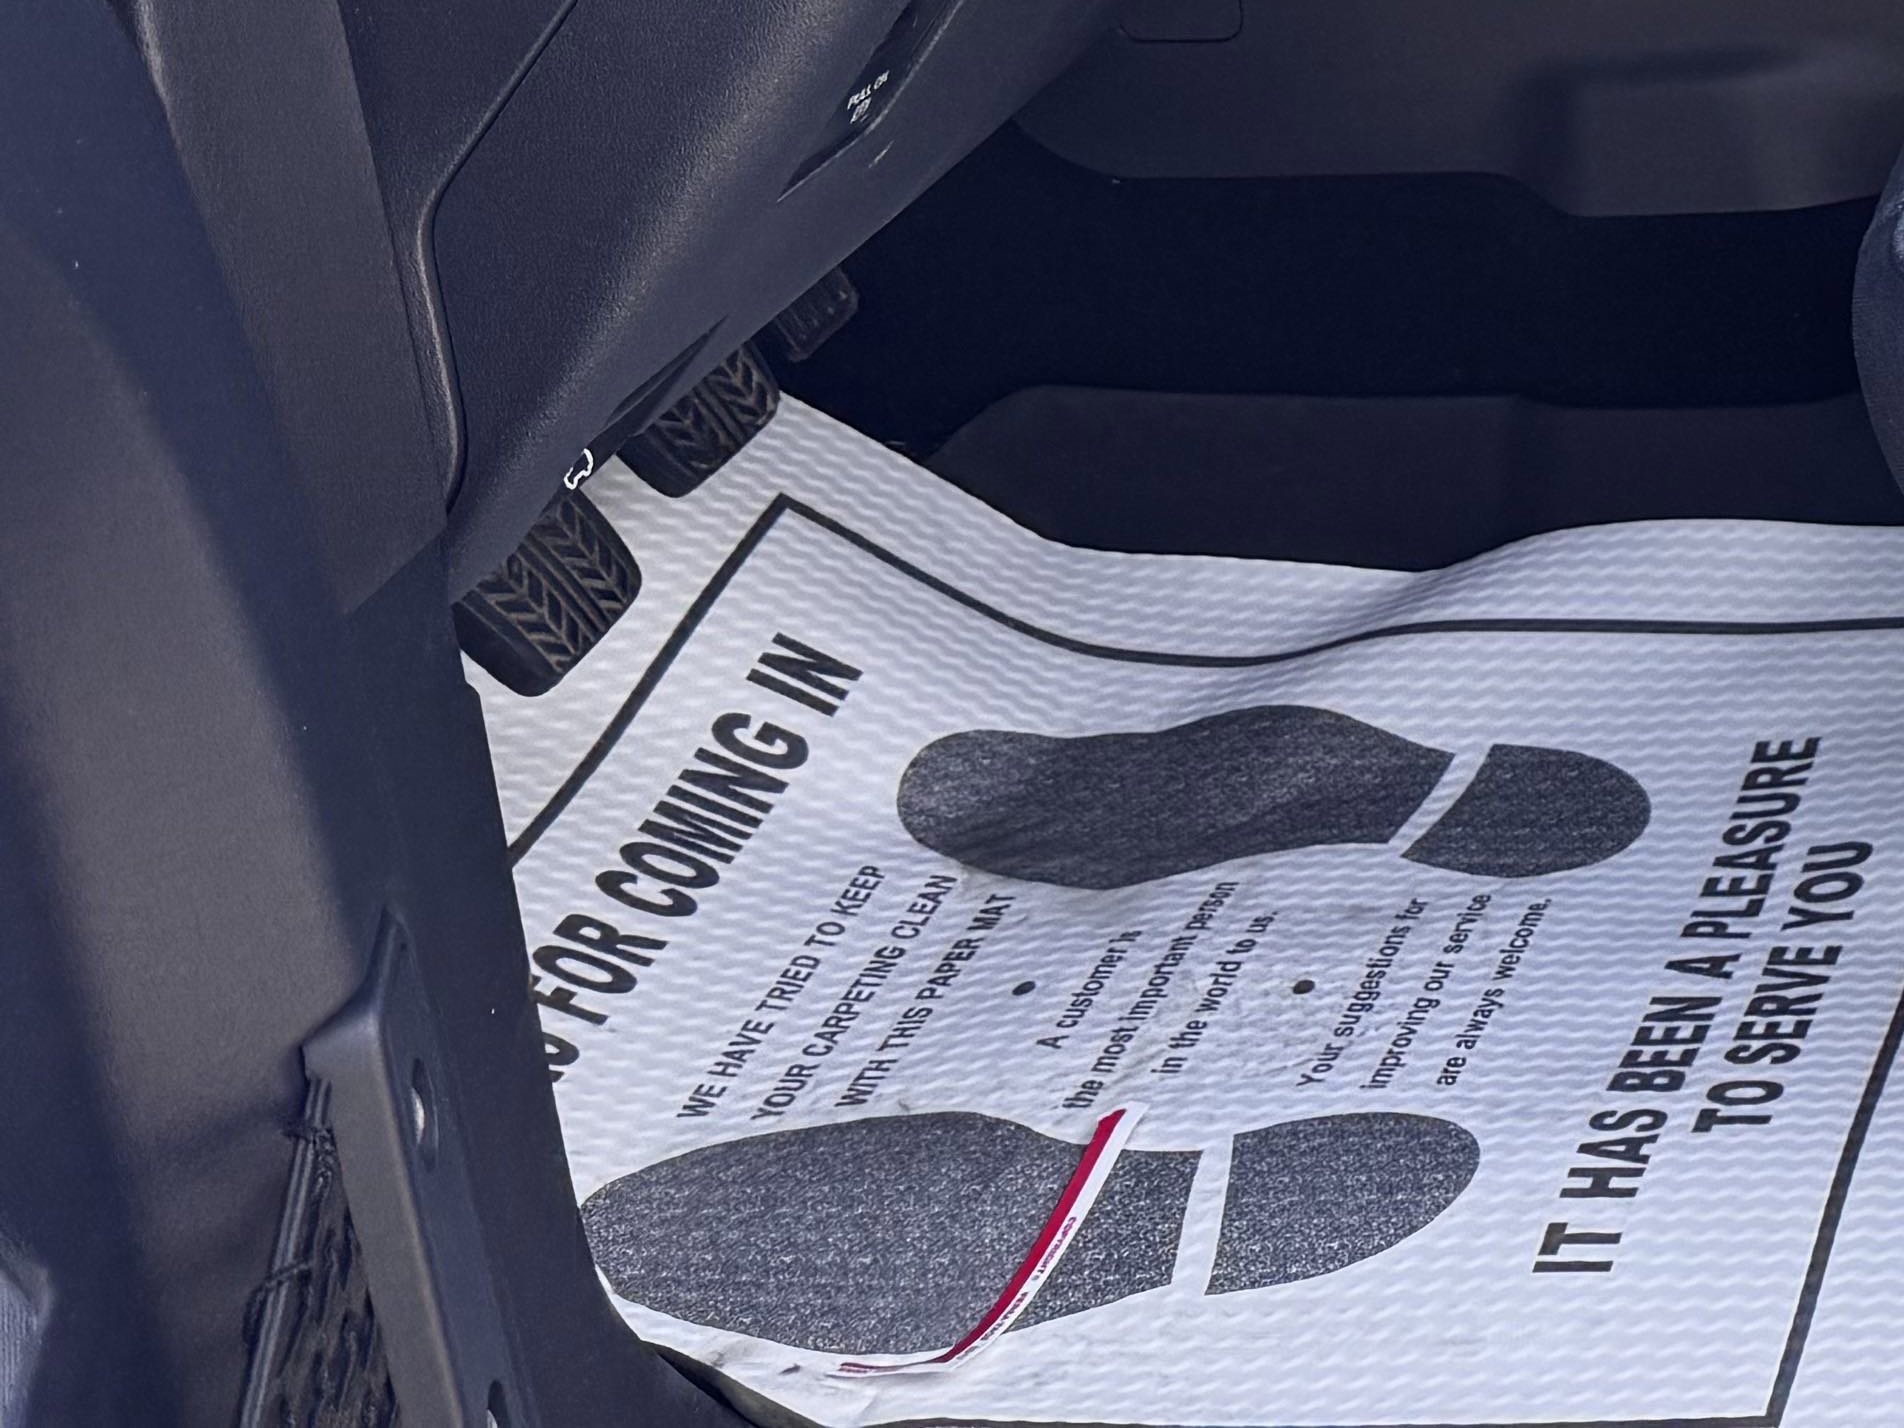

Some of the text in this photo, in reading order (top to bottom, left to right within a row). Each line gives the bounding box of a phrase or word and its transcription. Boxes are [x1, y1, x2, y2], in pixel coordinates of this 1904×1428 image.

[530, 632, 863, 1025] FOR COMING IN
[677, 865, 885, 1118] WE HAVE TRIED TO KEEP
[751, 875, 958, 1120] YOUR CARPETING CLEAN
[834, 894, 1016, 1107] WITH THIS PAPER MAT
[1036, 930, 1143, 1049] A customer is
[1061, 881, 1240, 1109] the most important person
[1150, 911, 1279, 1075] in the world to us.
[1296, 897, 1429, 1087] Your suggestions for
[1360, 894, 1491, 1090] improving our service
[1436, 1056, 1467, 1086] are
[1456, 989, 1505, 1050] always
[1531, 736, 1822, 1274] IT HAS BEEN A PLEASURE
[1691, 840, 1874, 1134] TO SERVE YOU
